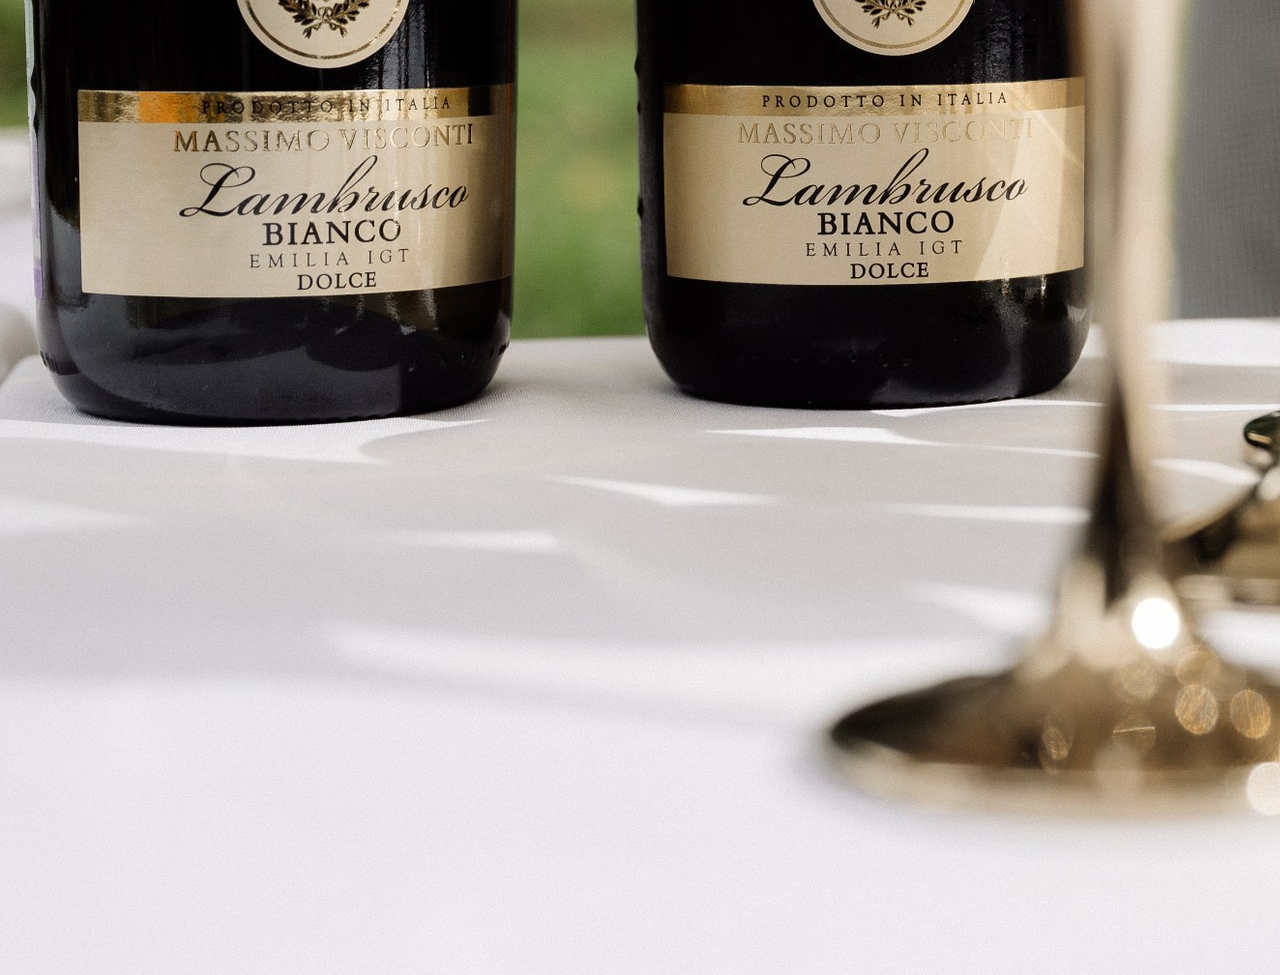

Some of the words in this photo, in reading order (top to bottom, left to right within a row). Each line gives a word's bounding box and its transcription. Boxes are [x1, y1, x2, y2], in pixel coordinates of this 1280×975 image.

[201, 99, 334, 115] PRODOTTO
[348, 98, 370, 113] IN
[385, 96, 452, 111] ITALIA
[762, 94, 885, 108] PRODOTTO
[900, 94, 922, 107] IN
[936, 91, 1008, 106] ITALIA
[173, 128, 330, 153] MASSIMO
[340, 123, 474, 150] VISCONTI
[737, 122, 882, 145] MASSIMO
[894, 118, 1034, 144] VISCONTI
[179, 155, 469, 217] Lambrusco
[742, 148, 1028, 207] Lambrusco
[262, 219, 401, 246] BIANCO
[817, 210, 955, 236] BIANCO
[249, 252, 350, 269] EMILIA
[368, 248, 410, 265] IGT
[806, 242, 902, 257] EMILIA
[919, 240, 964, 256] IGT
[297, 272, 377, 291] DOLCE
[850, 262, 930, 280] DOLCE
